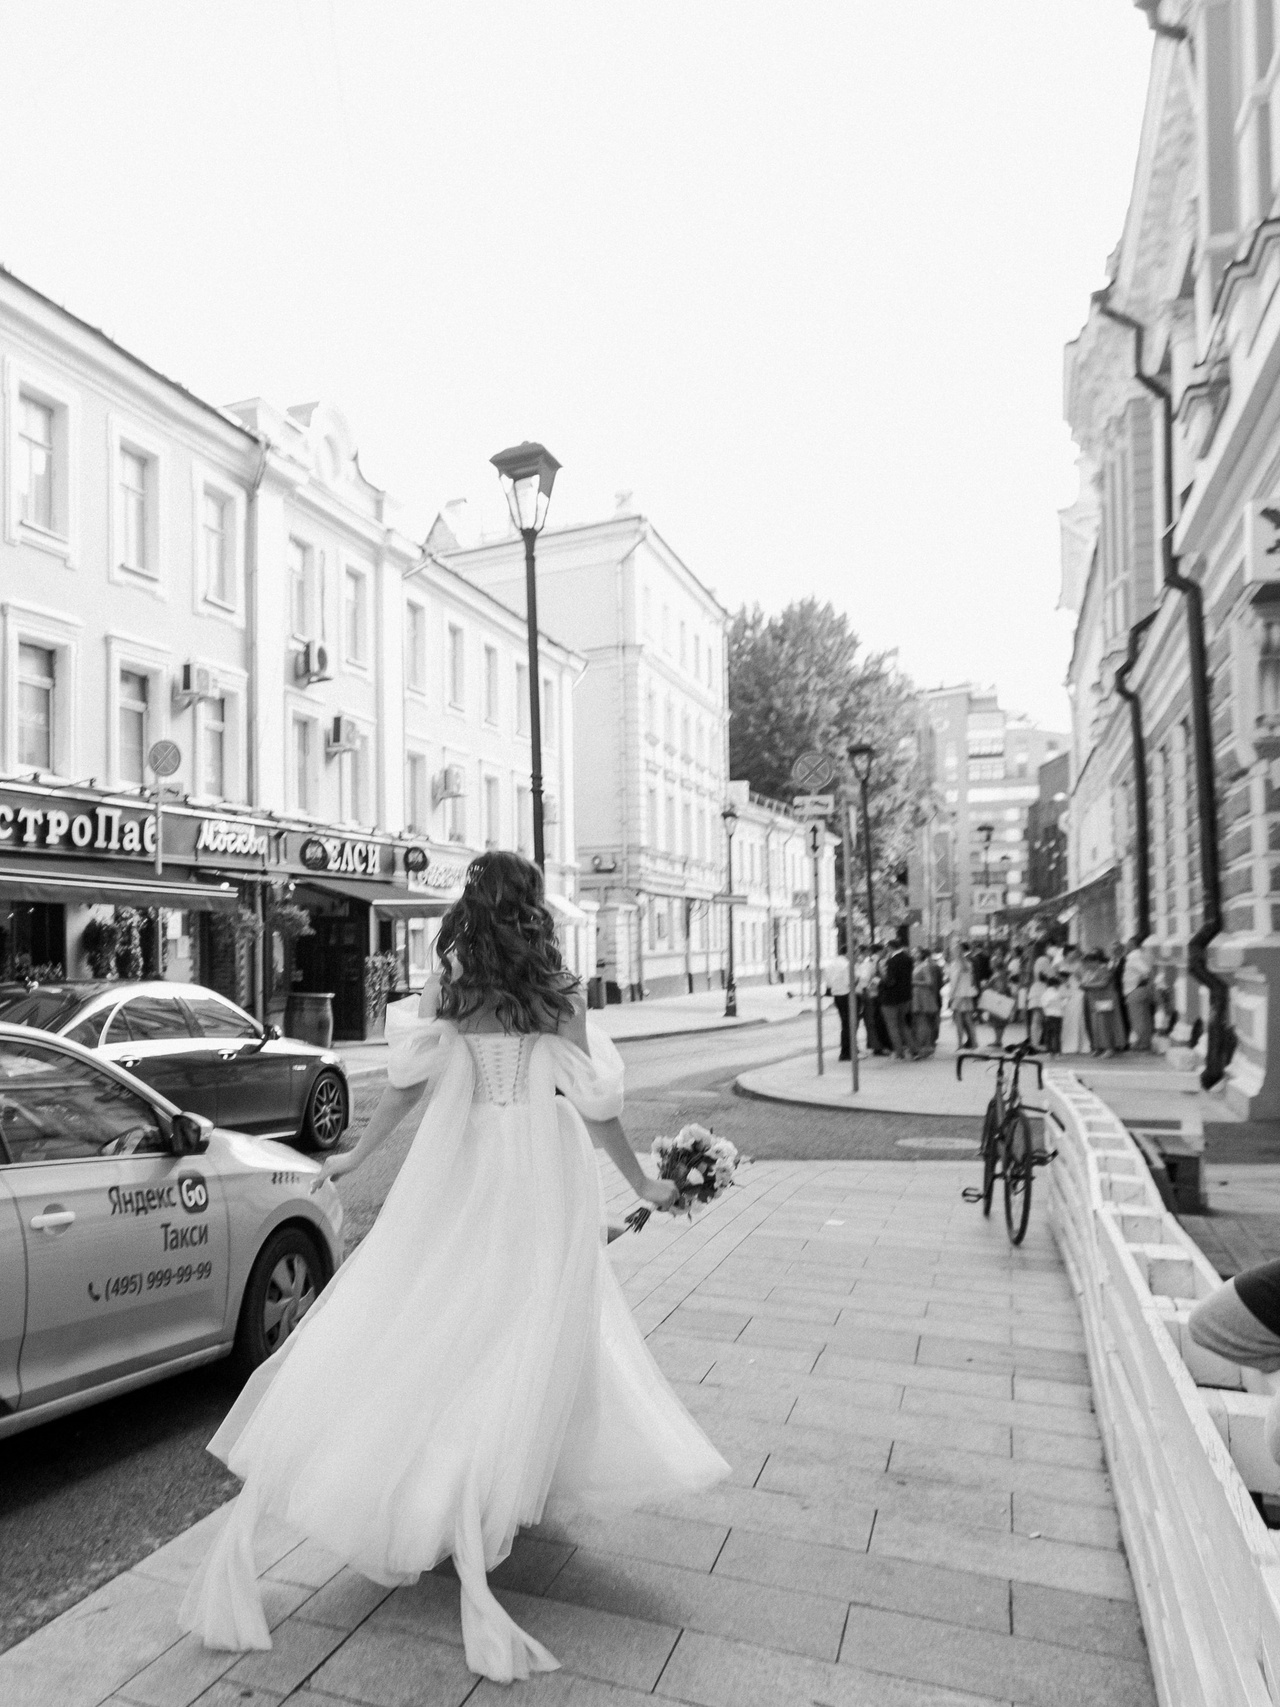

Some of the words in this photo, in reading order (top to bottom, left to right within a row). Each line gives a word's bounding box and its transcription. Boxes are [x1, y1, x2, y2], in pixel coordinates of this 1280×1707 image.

[312, 837, 381, 875] ЕЛСИ
[108, 1186, 177, 1216] Яндекс
[181, 1179, 207, 1208] Go
[160, 1222, 209, 1252] Такси
[105, 1273, 144, 1302] (495)
[147, 1261, 213, 1291] 999-99-99
